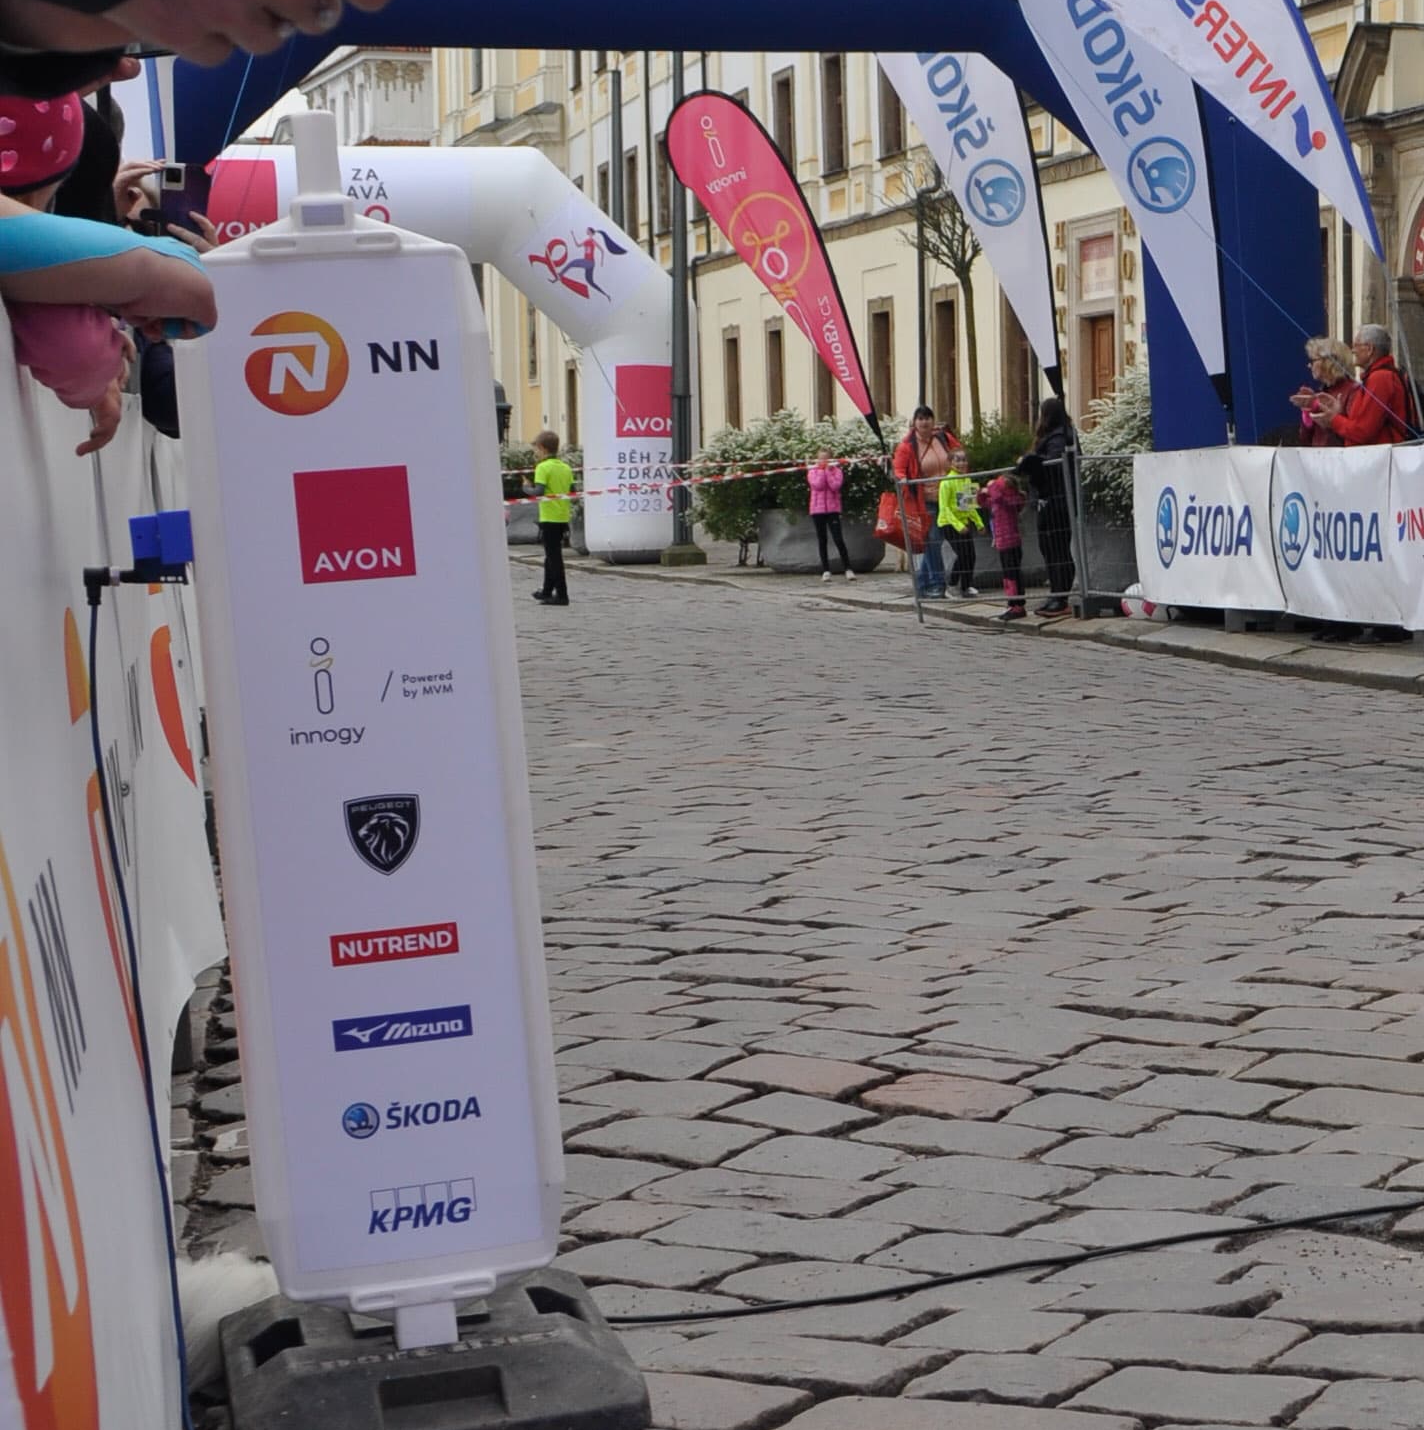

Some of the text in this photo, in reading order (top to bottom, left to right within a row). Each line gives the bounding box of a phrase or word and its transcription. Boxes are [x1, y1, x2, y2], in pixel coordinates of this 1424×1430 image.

[352, 168, 380, 182] ZA
[346, 182, 389, 200] AVÁ
[368, 338, 441, 375] NN
[618, 448, 673, 465] BĚH Z
[617, 499, 662, 513] 2023
[1180, 495, 1254, 558] ŠKODA
[1313, 502, 1384, 563] ŠKODA
[314, 546, 403, 574] AVON
[401, 669, 454, 685] Powered
[402, 683, 454, 700] by MVM
[289, 726, 366, 746] innogy
[350, 800, 413, 814] PEUGEOT
[337, 929, 453, 960] NUTREND
[385, 1096, 482, 1130] ŠKODA
[368, 1196, 473, 1236] KPMG
